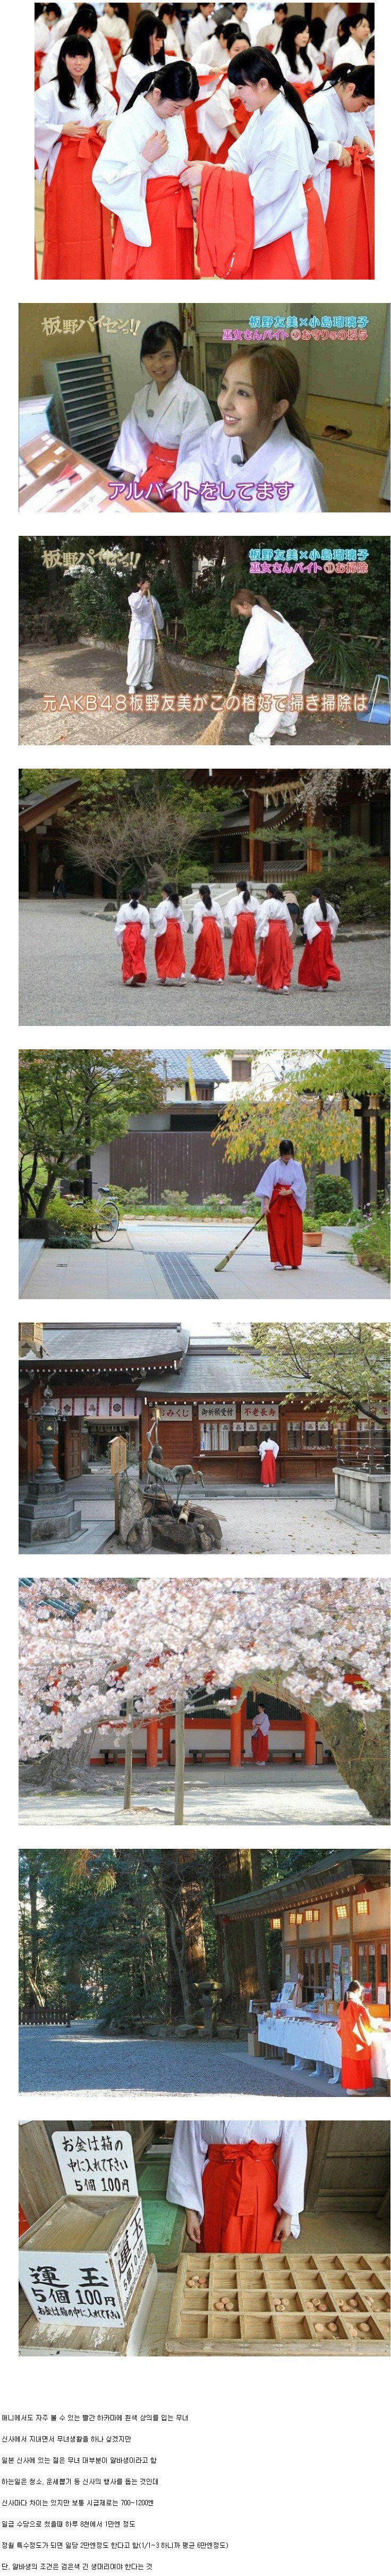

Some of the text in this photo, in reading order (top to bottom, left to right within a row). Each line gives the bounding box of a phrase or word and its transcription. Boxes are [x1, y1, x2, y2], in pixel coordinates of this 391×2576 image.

[244, 1408, 276, 1417] 不老長寿
[62, 2135, 123, 2152] お金は箱の
[67, 2158, 128, 2173] 中に入れて下さい
[75, 2178, 130, 2192] 5個 100円
[31, 2287, 116, 2307] 5個 100円
[37, 2305, 121, 2319] お金は箱の中に入れて下さい
